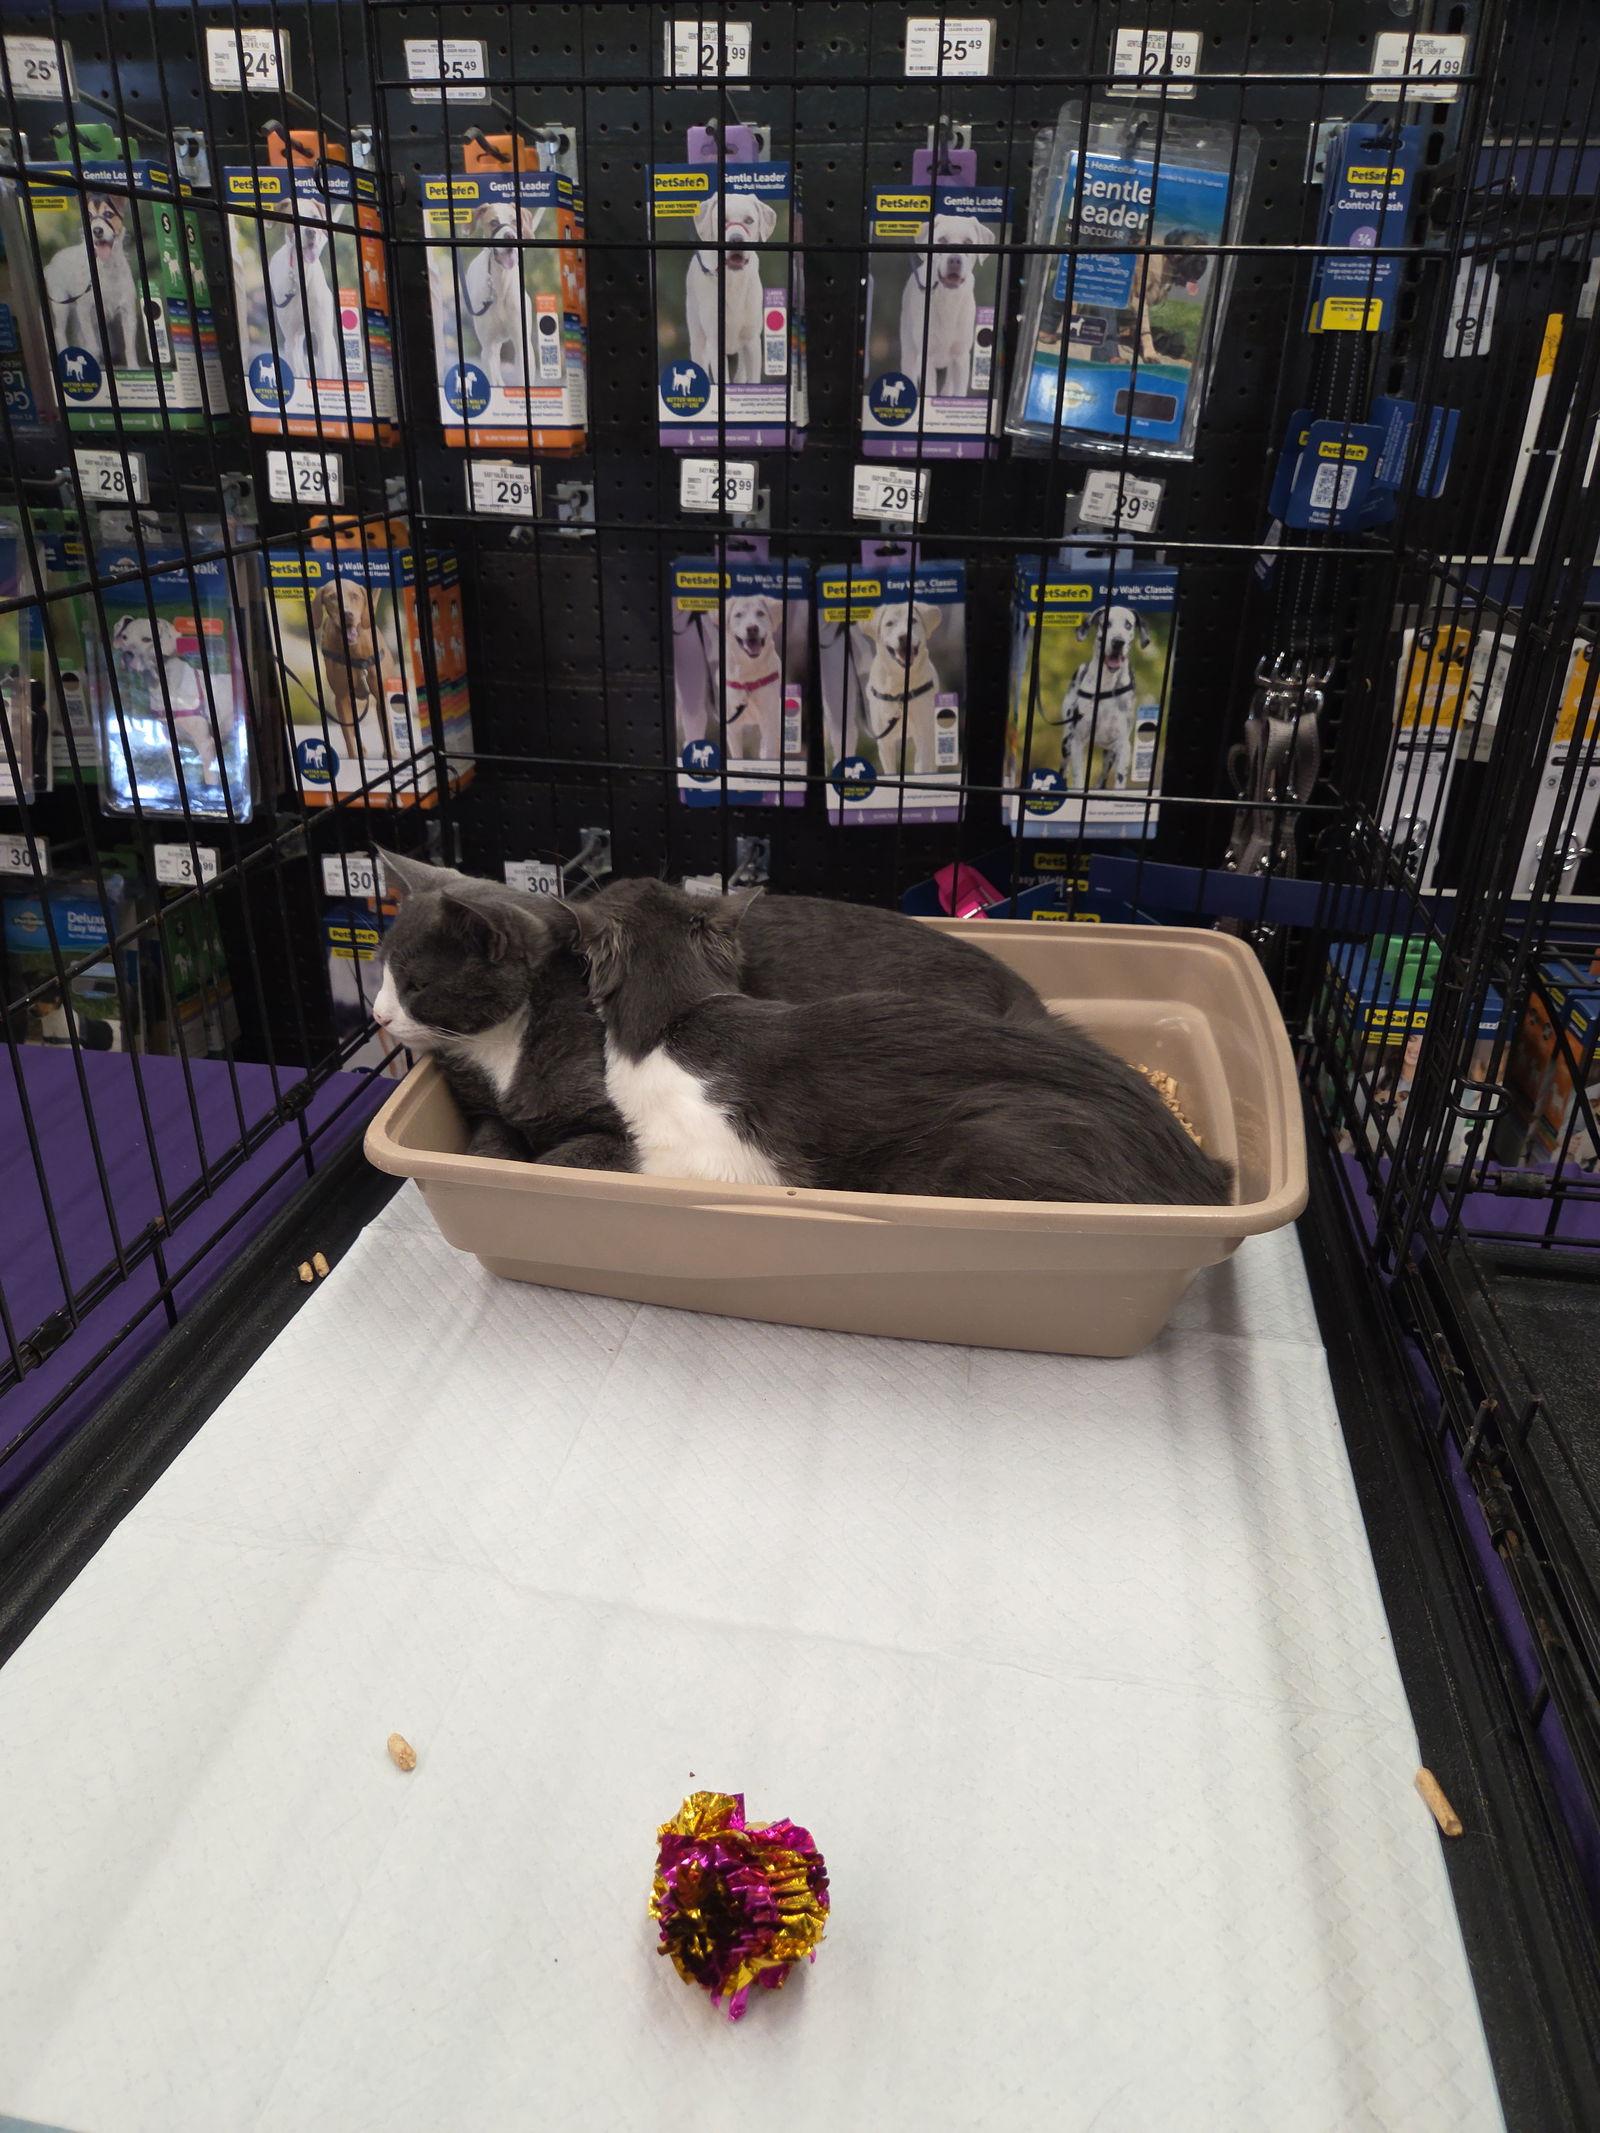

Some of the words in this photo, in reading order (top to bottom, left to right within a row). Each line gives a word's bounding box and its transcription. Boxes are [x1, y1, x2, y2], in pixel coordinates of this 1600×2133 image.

[82, 170, 112, 180] Gentle
[114, 170, 143, 181] Leaer
[655, 178, 696, 188] PetSafe
[754, 172, 786, 183] Leader
[233, 180, 270, 191] PetSfe
[429, 186, 466, 196] Petafe
[489, 182, 515, 192] Gentl
[520, 181, 551, 191] Leader
[1348, 189, 1369, 199] Two
[1370, 190, 1397, 200] Pot
[880, 198, 919, 209] PetSafe
[944, 196, 974, 206] Gentle
[975, 196, 1003, 206] Leade
[1338, 200, 1375, 211] Control
[1375, 202, 1404, 212] Lash
[1066, 224, 1126, 240] HADCOLLAR
[367, 562, 390, 571] Classi
[827, 586, 869, 596] Petafe
[1034, 589, 1078, 600] PtSafe
[1099, 585, 1119, 597] Eay
[1144, 585, 1175, 594] Classic
[1371, 1013, 1408, 1024] PeSaf
